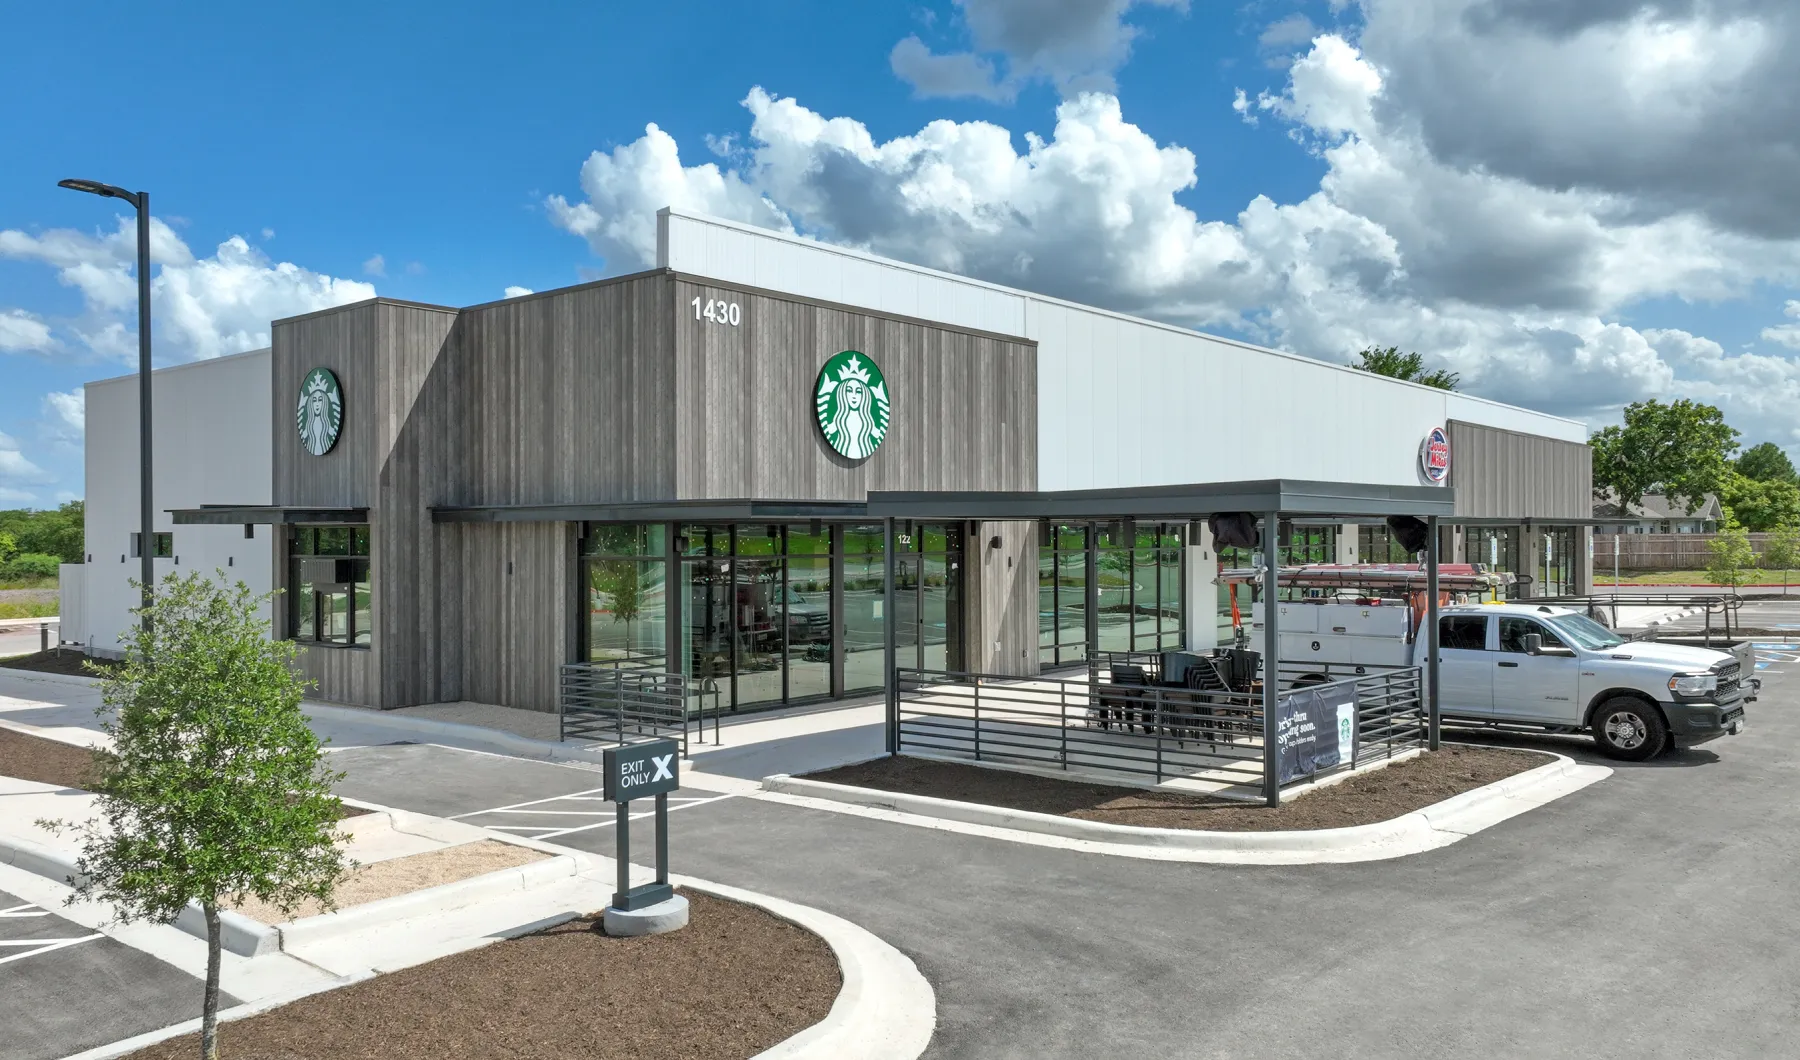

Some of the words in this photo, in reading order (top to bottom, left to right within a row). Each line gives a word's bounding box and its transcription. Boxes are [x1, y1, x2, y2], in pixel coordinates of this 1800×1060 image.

[691, 296, 740, 326] 1430
[898, 534, 911, 544] 122
[1300, 722, 1316, 733] soon.
[621, 759, 645, 775] EXIT
[621, 771, 651, 788] ONLY
